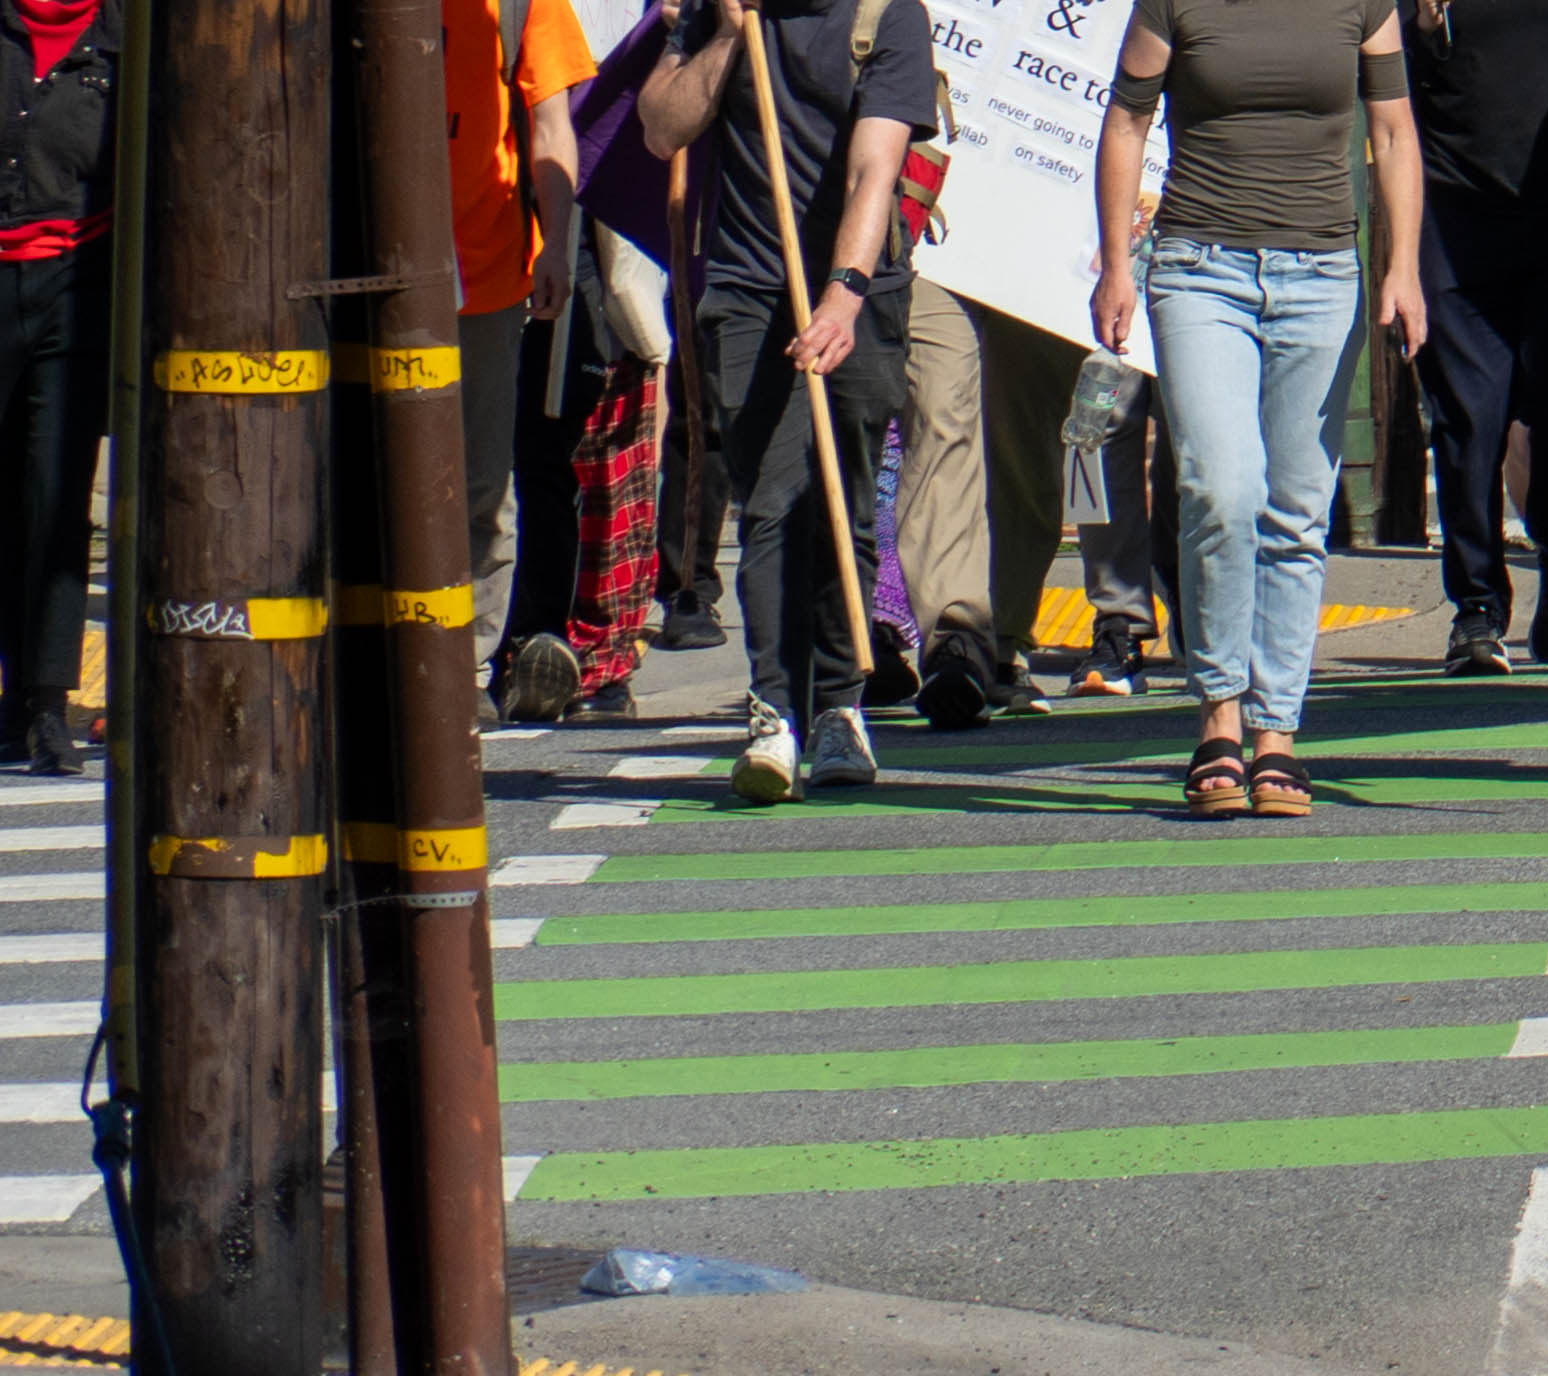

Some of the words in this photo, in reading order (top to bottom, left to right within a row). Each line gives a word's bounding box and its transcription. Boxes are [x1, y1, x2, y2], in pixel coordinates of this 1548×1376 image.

[930, 19, 984, 59] the
[1012, 49, 1079, 92] race
[987, 97, 1031, 124] never
[1033, 116, 1075, 144] going
[1078, 134, 1095, 150] to
[1014, 145, 1034, 161] on
[1037, 151, 1085, 185] safety
